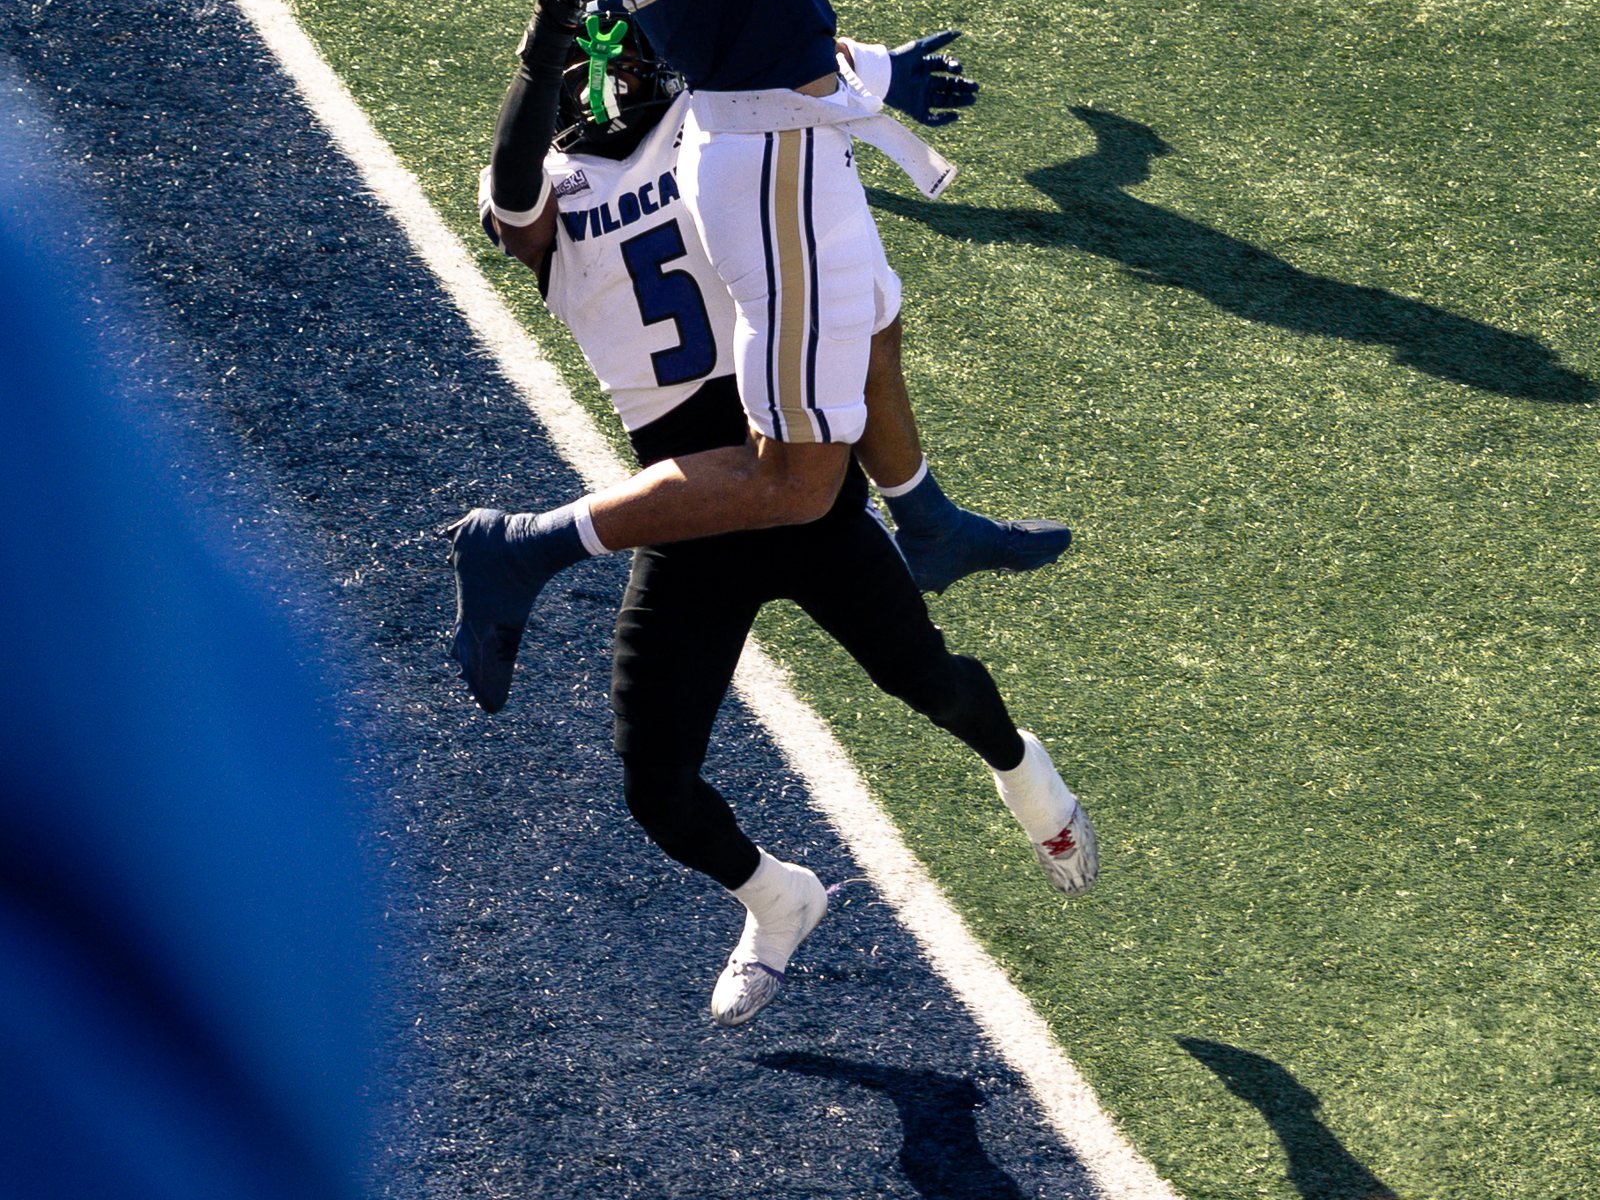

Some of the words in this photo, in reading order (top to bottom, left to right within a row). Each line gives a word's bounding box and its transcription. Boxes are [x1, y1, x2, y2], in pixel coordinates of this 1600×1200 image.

[559, 166, 680, 242] WILDCA
[563, 171, 586, 190] SKY
[619, 217, 717, 388] 5
